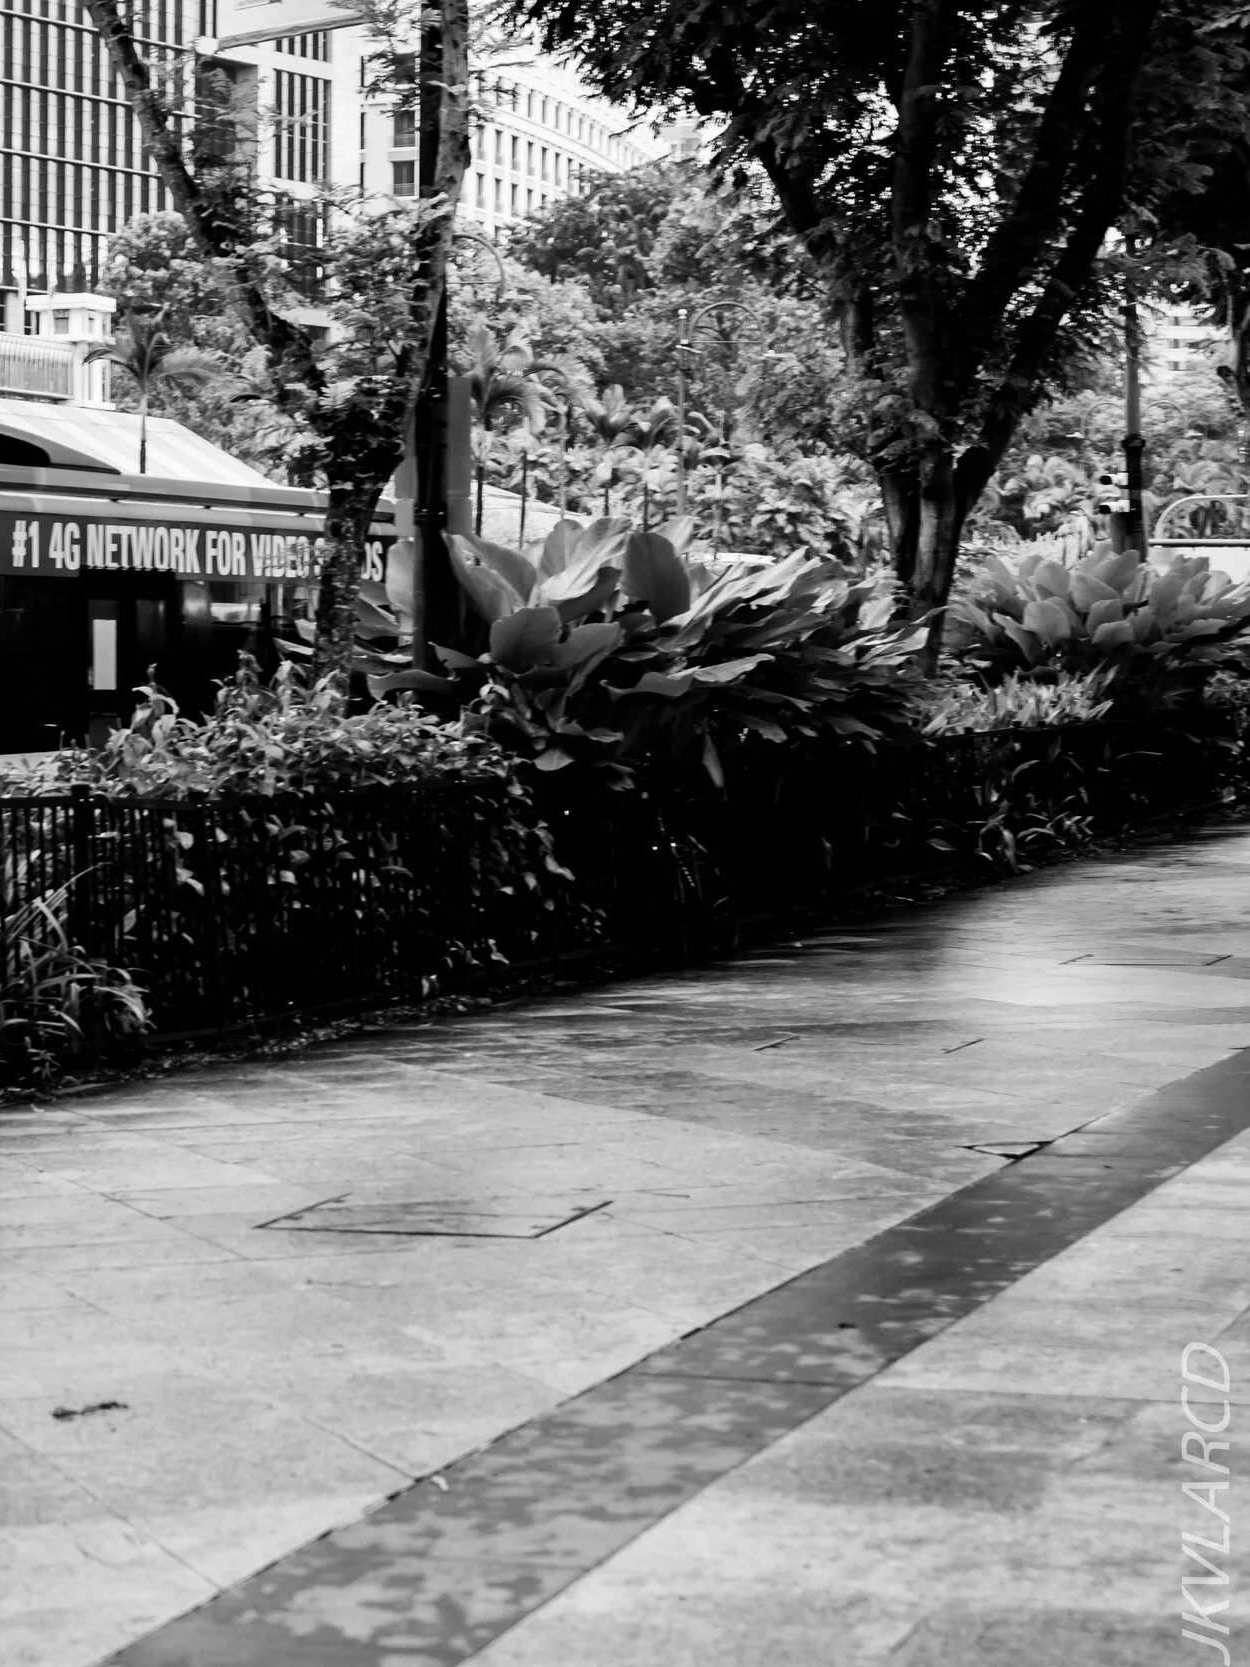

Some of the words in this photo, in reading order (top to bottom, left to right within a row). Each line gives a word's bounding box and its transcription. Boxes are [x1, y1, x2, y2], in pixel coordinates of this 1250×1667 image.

[12, 520, 40, 568] #1
[49, 522, 81, 570] 4G
[86, 524, 200, 574] NETWORK
[205, 530, 246, 576] FOR
[250, 533, 310, 578] VIDEO
